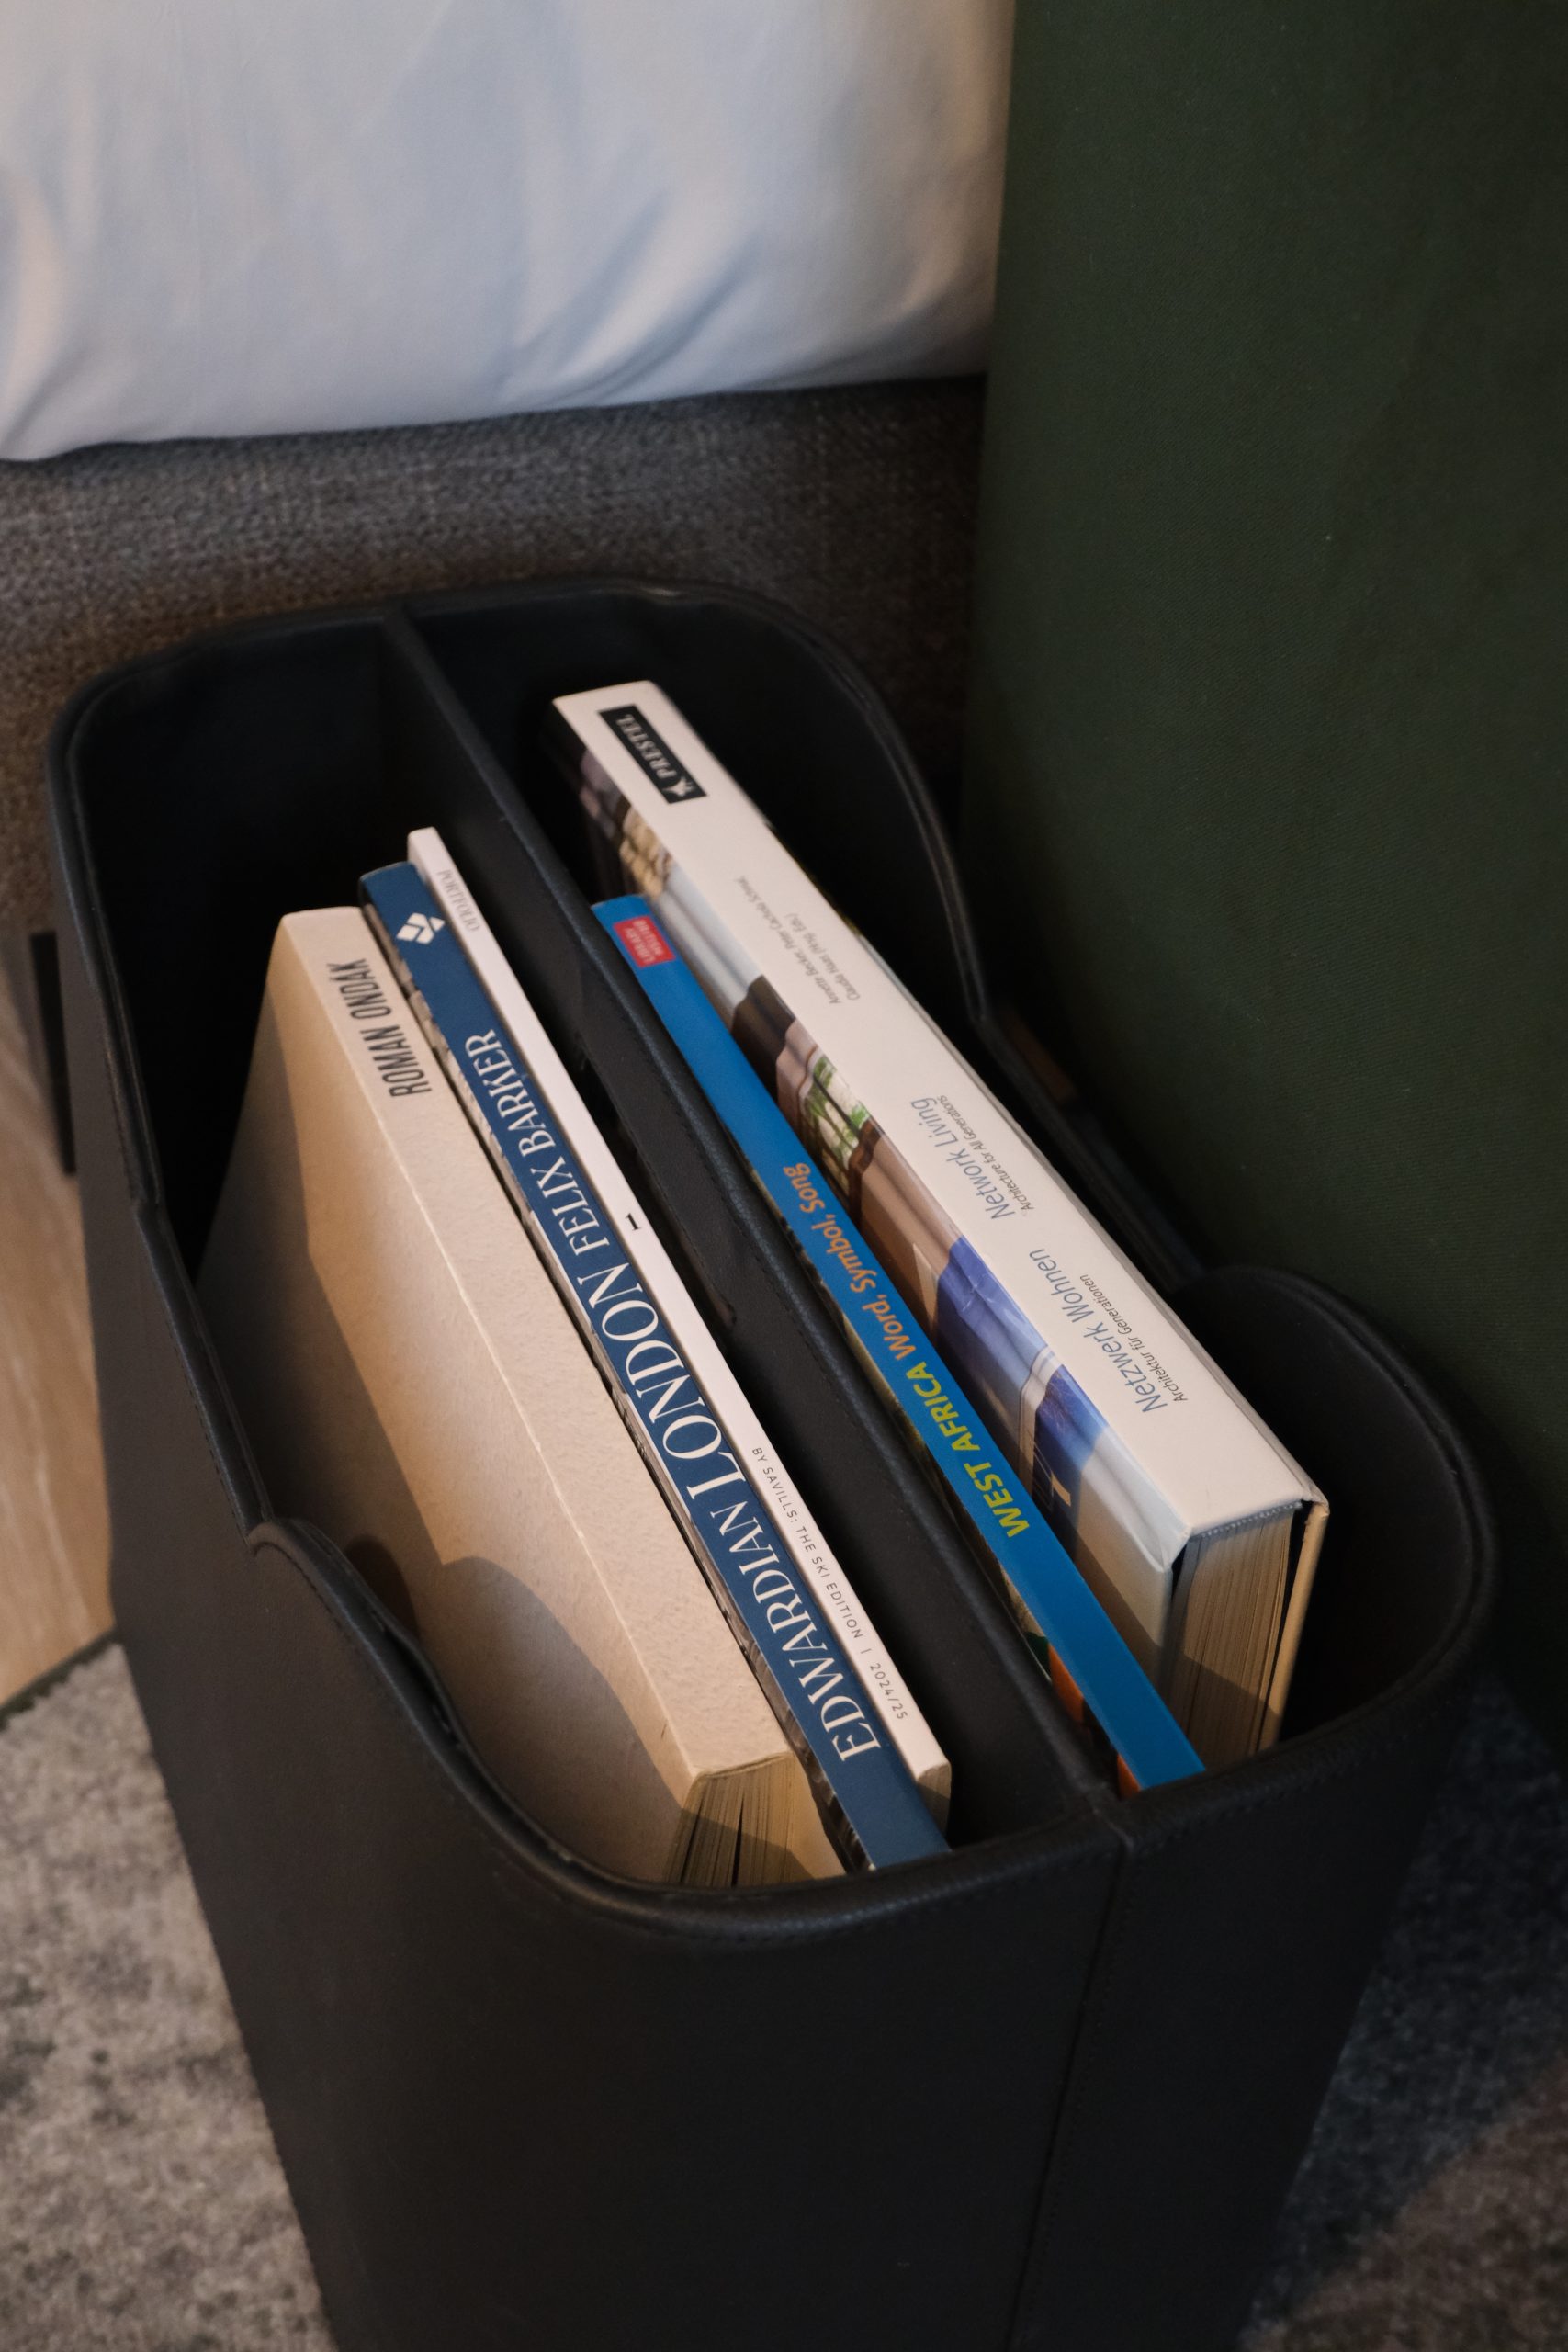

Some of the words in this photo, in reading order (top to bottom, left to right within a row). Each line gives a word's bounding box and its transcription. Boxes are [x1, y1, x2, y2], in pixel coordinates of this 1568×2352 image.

[615, 714, 677, 779] PRESTEL
[436, 870, 480, 932] PORTFOLIO
[779, 930, 797, 950] Peter
[326, 958, 392, 1019] ONDÁK
[815, 976, 841, 1004] Annette
[835, 974, 860, 1001] Claudia
[360, 1024, 432, 1097] ROMAN
[465, 1029, 557, 1157] BARKER
[911, 1098, 958, 1148] Living
[938, 1095, 977, 1140] Generations
[969, 1140, 987, 1150] All
[981, 1152, 997, 1164] for
[530, 1156, 611, 1256] FELIX
[784, 1163, 825, 1213] Song
[946, 1148, 1016, 1219] Network
[992, 1163, 1034, 1211] Architecture
[625, 1213, 642, 1232] 1
[811, 1214, 877, 1293] Symbol,
[1029, 1249, 1094, 1323] Wohnen
[1079, 1274, 1132, 1334] Generationen
[863, 1294, 917, 1360] Word,
[1128, 1337, 1144, 1351] für
[577, 1262, 747, 1499] LONDON
[1083, 1322, 1168, 1412] Netzwerk
[1141, 1352, 1188, 1402] Architektur
[906, 1361, 981, 1451] AFRICA
[964, 1462, 1030, 1538] WEST
[752, 1447, 768, 1462] BY
[762, 1466, 797, 1523] SAVILLS:
[796, 1526, 817, 1552] THE
[812, 1556, 830, 1578] SKI
[826, 1582, 864, 1639] EDITION
[870, 1663, 908, 1720] 2024/25
[710, 1500, 882, 1761] EDWARDIAN
